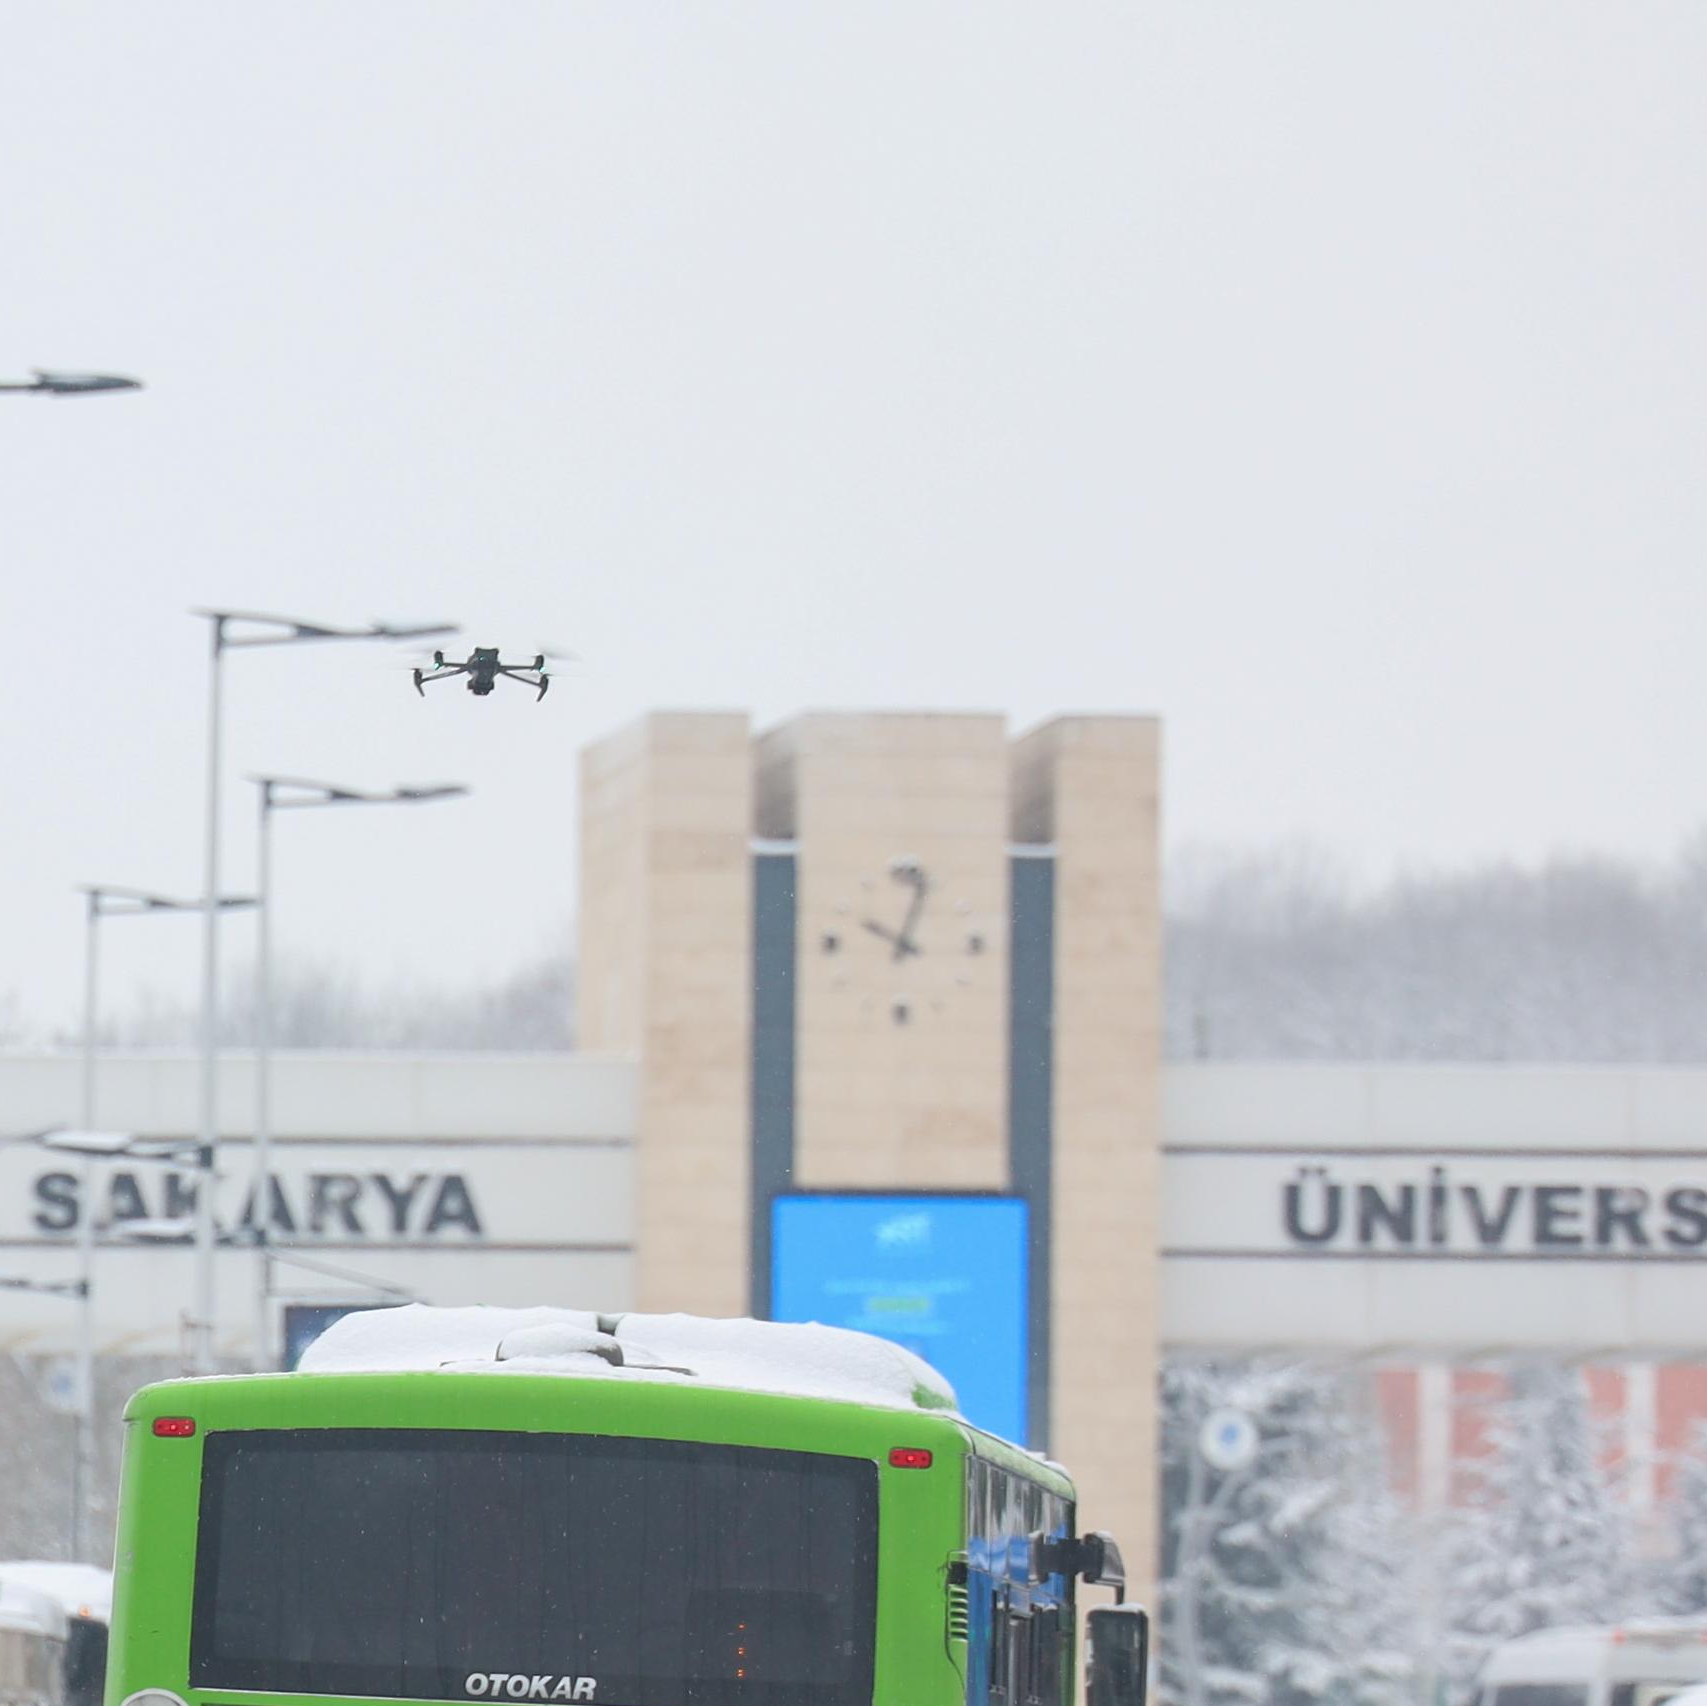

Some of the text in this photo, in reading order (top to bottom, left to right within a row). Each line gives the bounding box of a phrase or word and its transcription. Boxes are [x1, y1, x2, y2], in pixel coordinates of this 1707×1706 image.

[34, 1172, 483, 1234] SAKARYA
[1282, 1167, 1707, 1246] ÜNİVERS
[465, 1672, 597, 1700] OTOKAR
